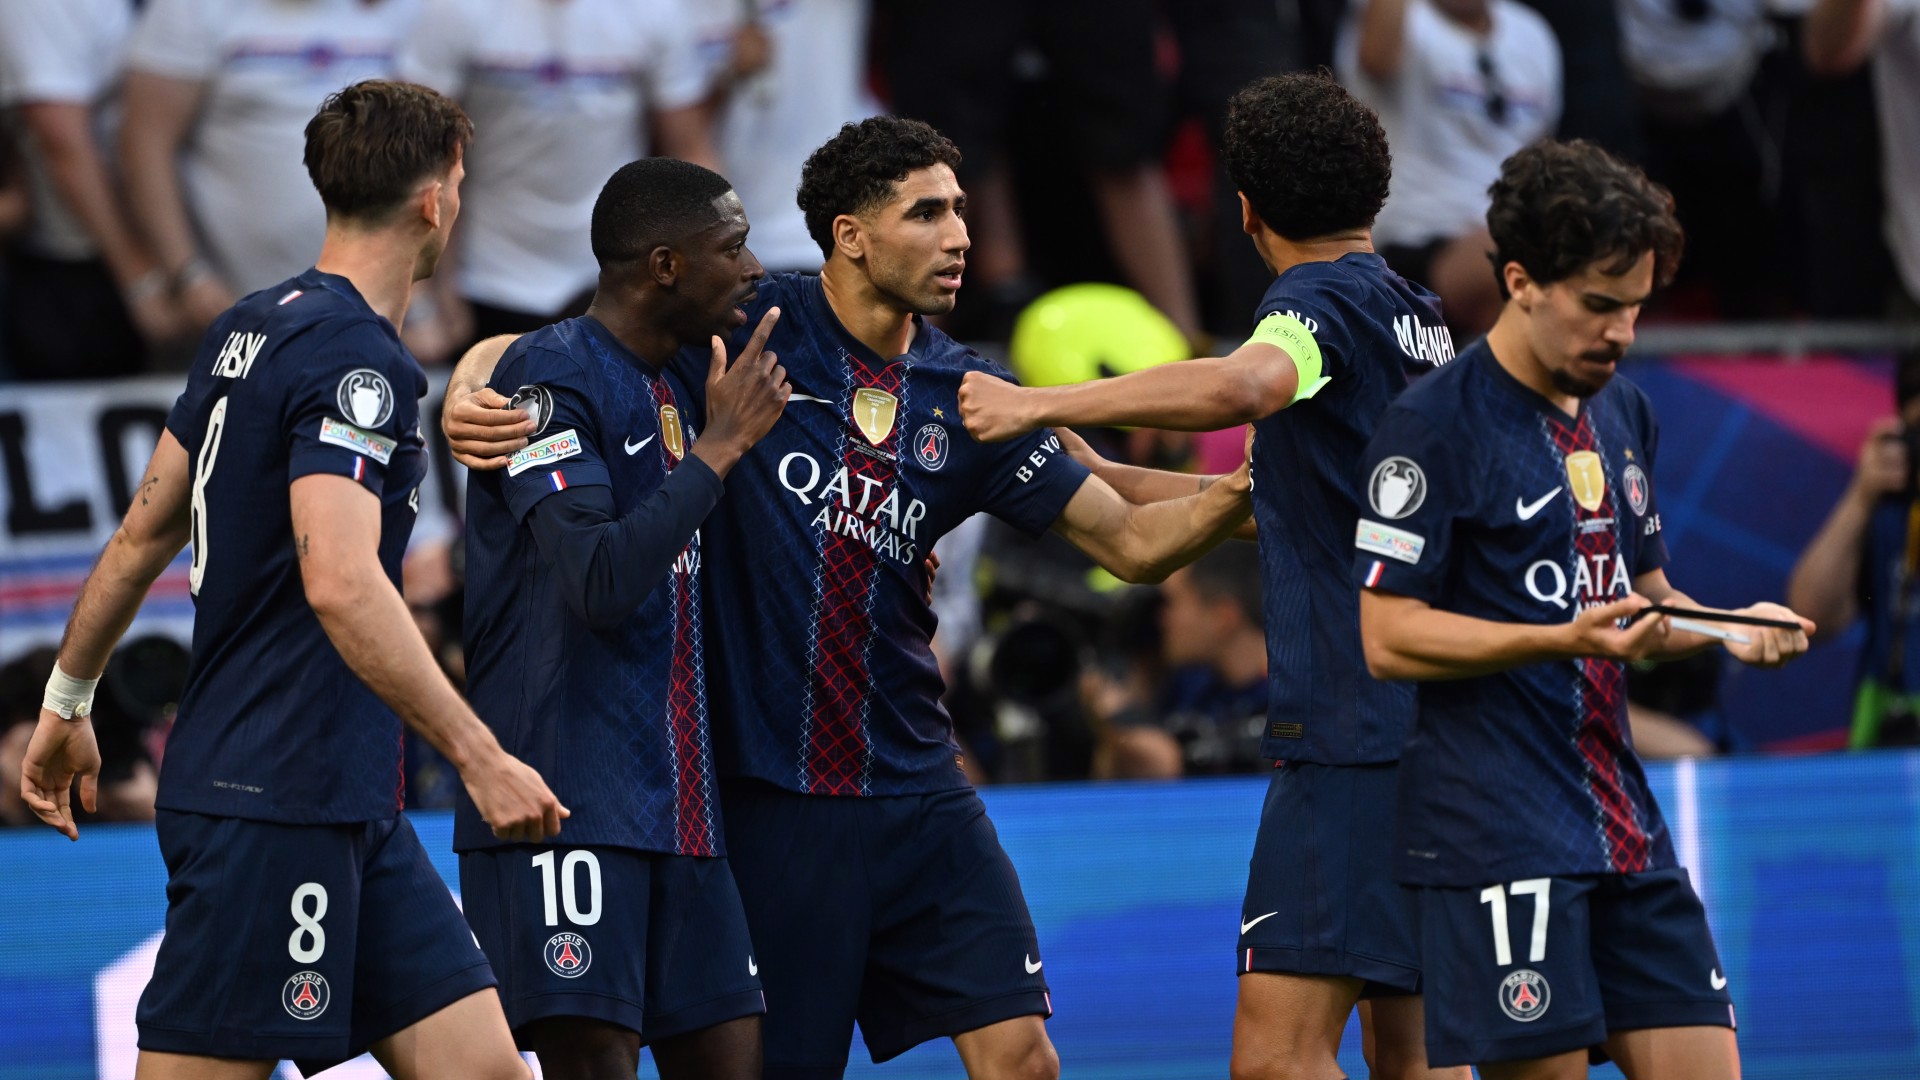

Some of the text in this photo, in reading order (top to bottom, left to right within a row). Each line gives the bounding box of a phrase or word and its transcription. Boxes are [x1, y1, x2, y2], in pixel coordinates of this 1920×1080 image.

[1266, 327, 1314, 361] RESPECT
[922, 425, 946, 441] PARIS
[778, 452, 926, 540] QATAR
[810, 506, 917, 565] AIRWAYS
[1524, 553, 1632, 609] QATA
[531, 849, 602, 926] 10
[288, 883, 328, 963] 8
[551, 935, 583, 946] PARIS
[1480, 878, 1551, 966] 17
[291, 973, 323, 985] PARIS
